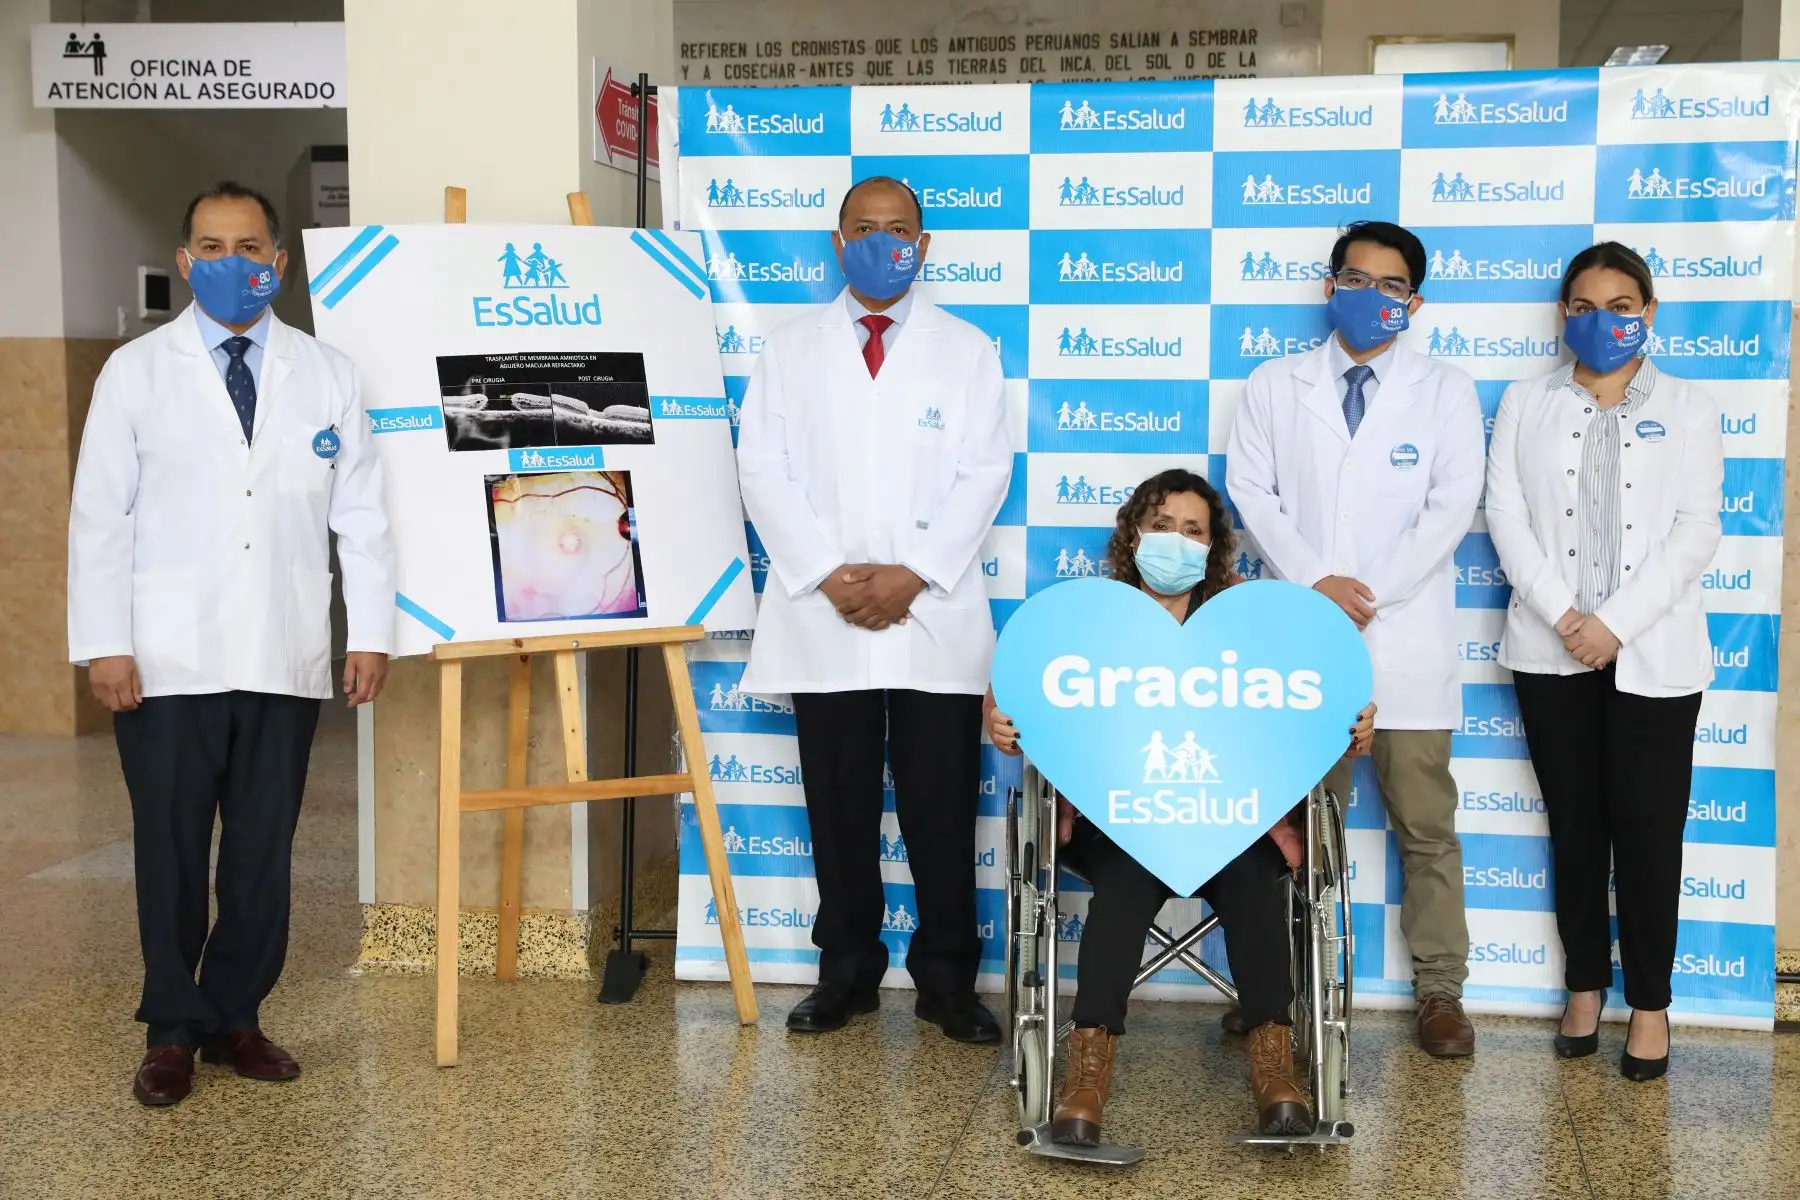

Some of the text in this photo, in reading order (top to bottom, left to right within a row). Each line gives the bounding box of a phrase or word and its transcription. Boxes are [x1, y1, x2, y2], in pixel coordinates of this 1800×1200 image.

[681, 28, 1258, 59] REFIEREN LOS CRONISTAS QUE LOS ANTIGUOS PERUANOS SALIAN A SEMBRAR
[130, 60, 252, 77] OFICINA DE
[680, 65, 689, 81] Y
[703, 65, 711, 81] A
[866, 60, 894, 77] QUE
[907, 59, 934, 76] LAS
[948, 57, 1007, 75] TIERRAS
[1020, 57, 1047, 73] DEL
[1060, 55, 1096, 73] INCA.
[1105, 54, 1132, 71] DEL
[1145, 53, 1172, 70] SOL
[1185, 53, 1195, 69] O
[1207, 51, 1226, 69] DE
[1238, 51, 1257, 68] LA
[48, 78, 335, 100] ATENCIÓN AL ASEGURADO
[617, 98, 639, 122] Tránsit
[1289, 104, 1373, 127] EsSalud
[1480, 101, 1567, 124] EsSalud
[1679, 95, 1769, 118] EsSalud
[747, 112, 824, 134] EsSalud
[923, 111, 1001, 132] EsSalud
[1103, 108, 1185, 130] EsSalud
[616, 119, 638, 141] COVID-
[923, 187, 1001, 208] EsSalud
[1103, 185, 1184, 206] EsSalud
[1287, 183, 1370, 205] EsSalud
[1478, 180, 1564, 202] EsSalud
[1675, 175, 1765, 199] EsSalud
[747, 188, 824, 208] EsSalud
[902, 246, 912, 258] 80
[260, 271, 270, 283] 80
[749, 262, 824, 282] EsSalud
[923, 263, 1001, 283] EsSalud
[1102, 261, 1183, 282] EsSalud
[1286, 262, 1332, 281] EsSa
[1476, 258, 1562, 280] EsSalud
[1673, 255, 1762, 278] EsSalud
[472, 293, 602, 328] EsSalud
[1391, 308, 1402, 318] 80
[1624, 321, 1639, 335] 80
[1101, 337, 1182, 357] EsSalud
[1474, 336, 1559, 357] EsSalud
[1669, 334, 1759, 357] EsSalud
[684, 403, 726, 417] EsSalud
[380, 413, 433, 430] EsSalud
[1100, 411, 1181, 432] EsSalud
[548, 455, 595, 467] EsSalud
[1702, 568, 1750, 589] alud
[1042, 650, 1322, 710] Gracias
[752, 698, 795, 715] EsSa
[1464, 716, 1525, 736] EsSal
[1694, 722, 1747, 744] alud
[751, 765, 801, 784] EsSal
[1108, 788, 1259, 825] EsSalud
[1687, 799, 1747, 822] Salud
[749, 836, 812, 856] EsSalu
[1463, 866, 1546, 889] EsSalud
[1680, 877, 1745, 899] Salud
[1672, 954, 1745, 978] sSalud
